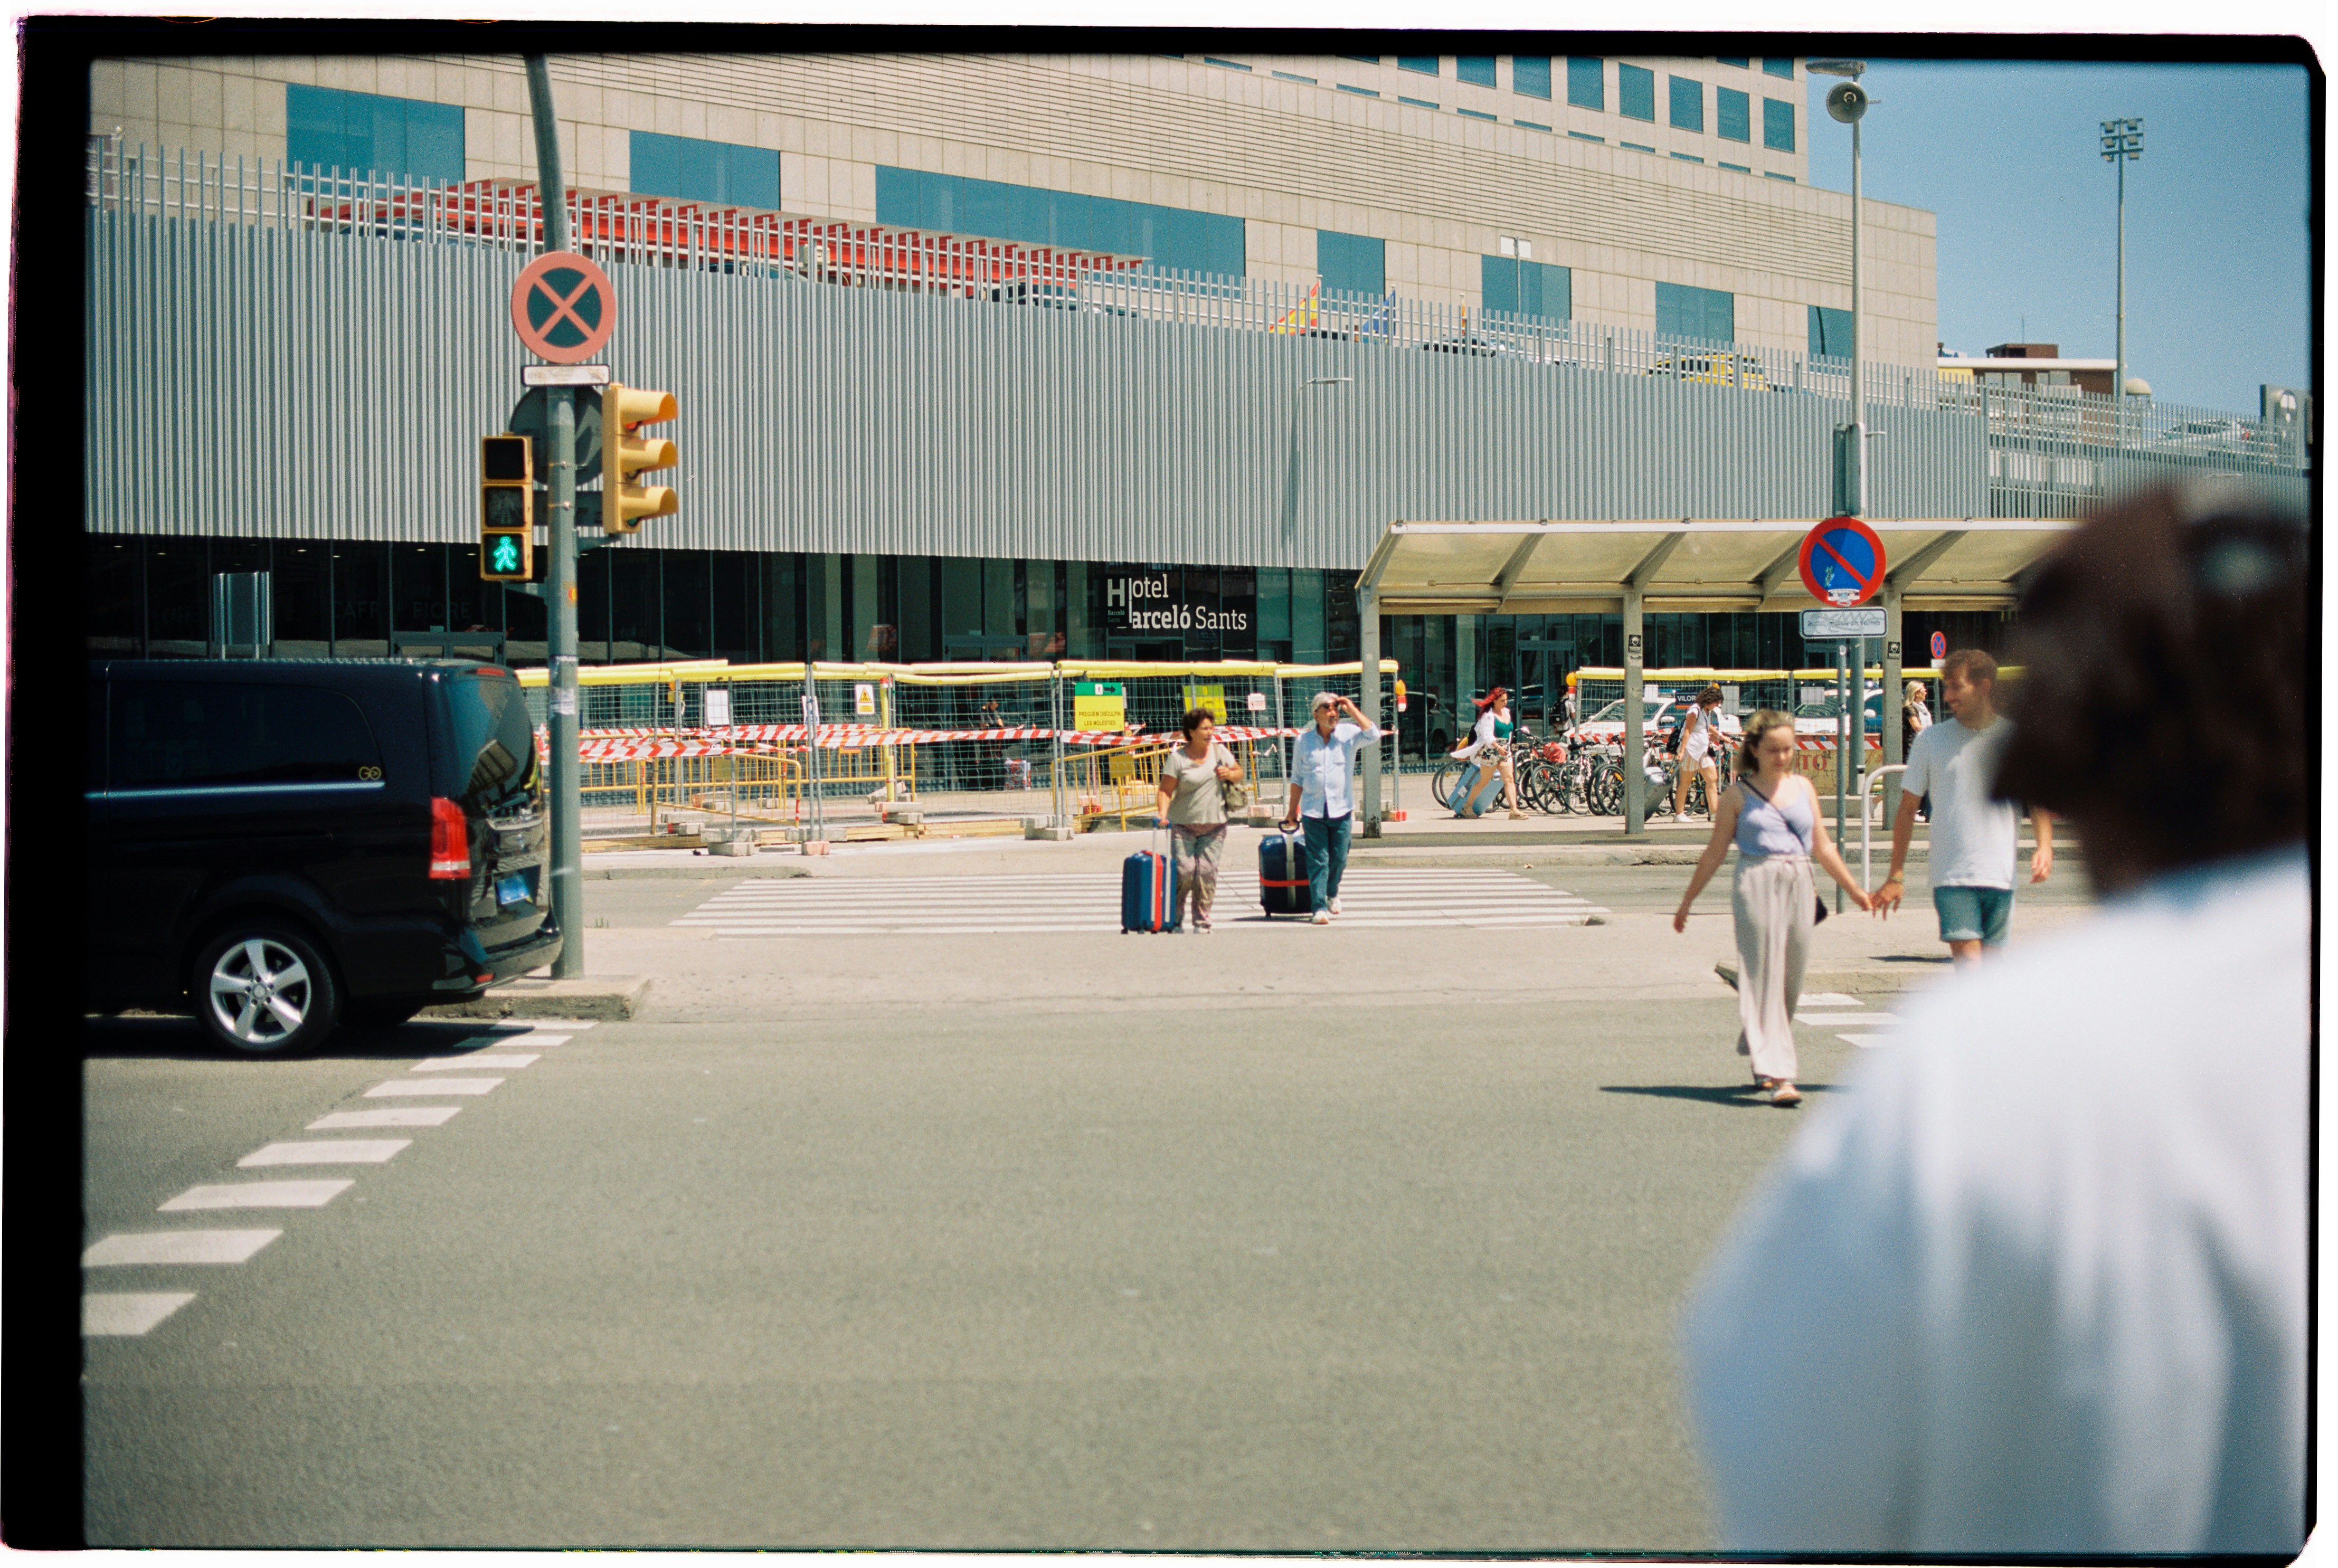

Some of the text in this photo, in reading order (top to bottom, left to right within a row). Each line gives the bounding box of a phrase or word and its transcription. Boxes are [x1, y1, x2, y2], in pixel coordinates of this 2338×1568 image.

[1132, 573, 1169, 598] otel
[1132, 604, 1247, 630] arceló Sants
